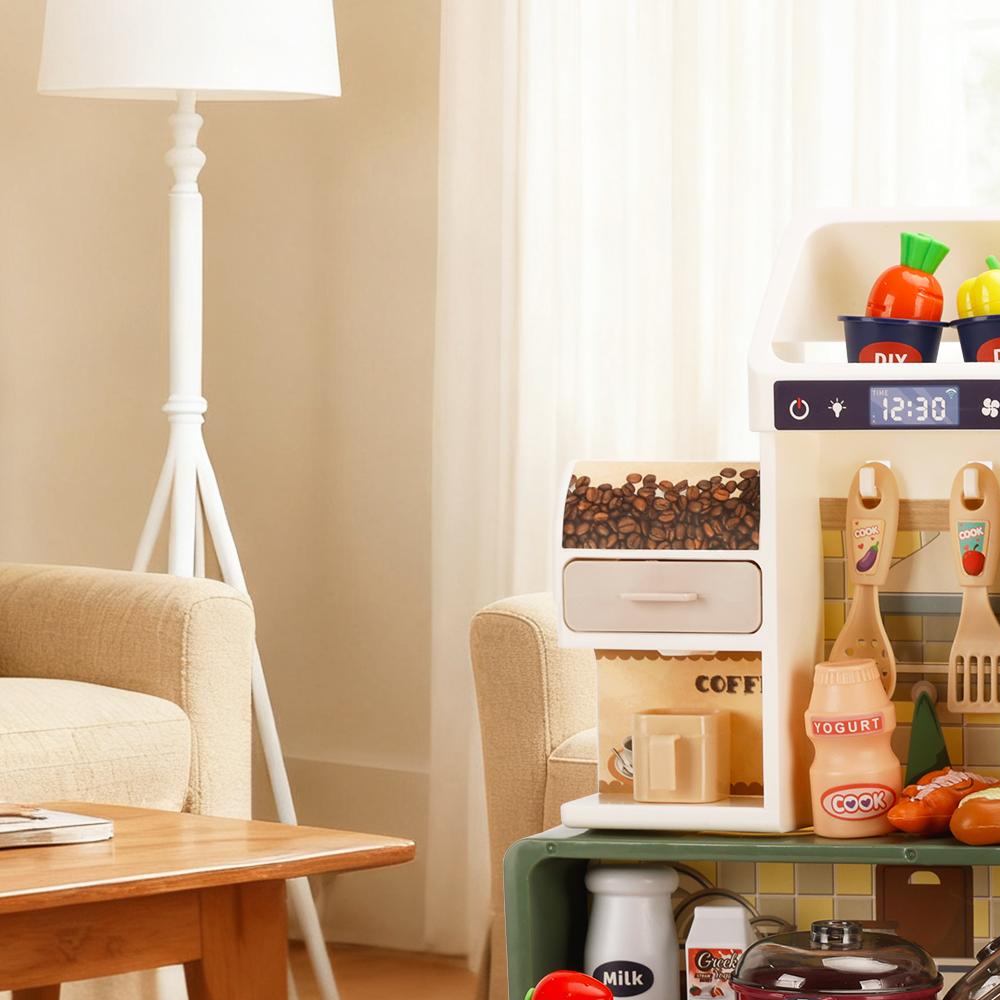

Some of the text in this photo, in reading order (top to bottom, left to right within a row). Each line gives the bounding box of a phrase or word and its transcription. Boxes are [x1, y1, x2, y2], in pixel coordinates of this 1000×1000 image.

[872, 389, 888, 397] TIME
[882, 397, 946, 421] 12:30
[854, 527, 879, 538] COOK
[959, 527, 984, 539] COOK
[695, 675, 762, 693] COFF
[813, 717, 880, 734] YOGURT
[831, 791, 887, 814] COOK
[697, 952, 738, 969] Greek
[602, 971, 644, 986] Milk
